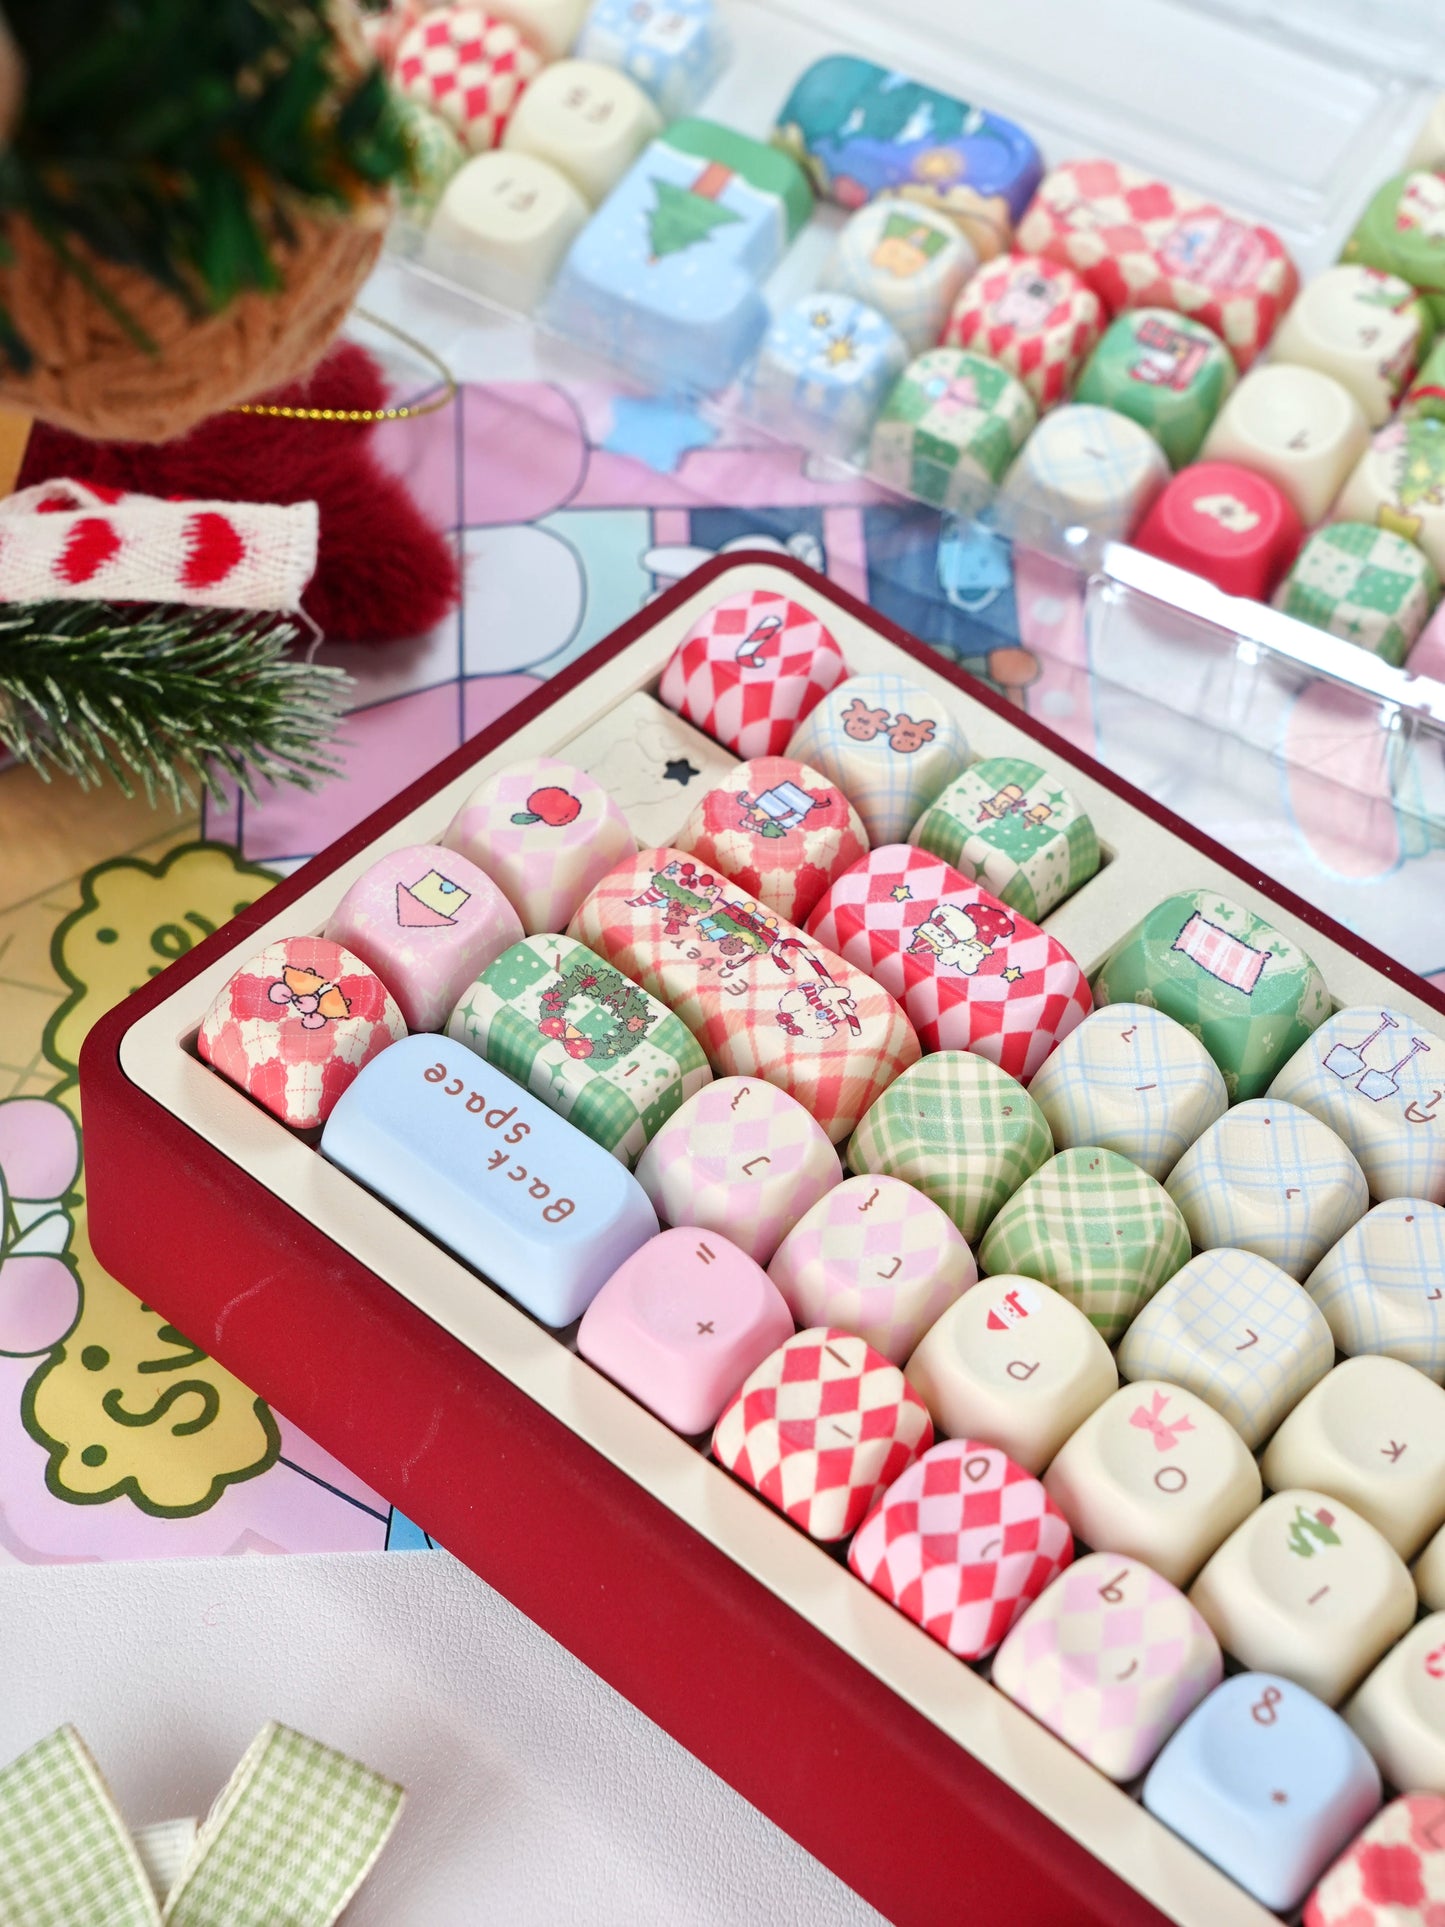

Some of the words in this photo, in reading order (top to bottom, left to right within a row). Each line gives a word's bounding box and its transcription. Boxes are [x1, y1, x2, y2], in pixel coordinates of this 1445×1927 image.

[670, 938, 749, 998] Enter
[423, 1062, 532, 1145] space
[487, 1148, 576, 1224] Back
[1006, 1361, 1040, 1381] P
[1251, 1685, 1282, 1725] 8
